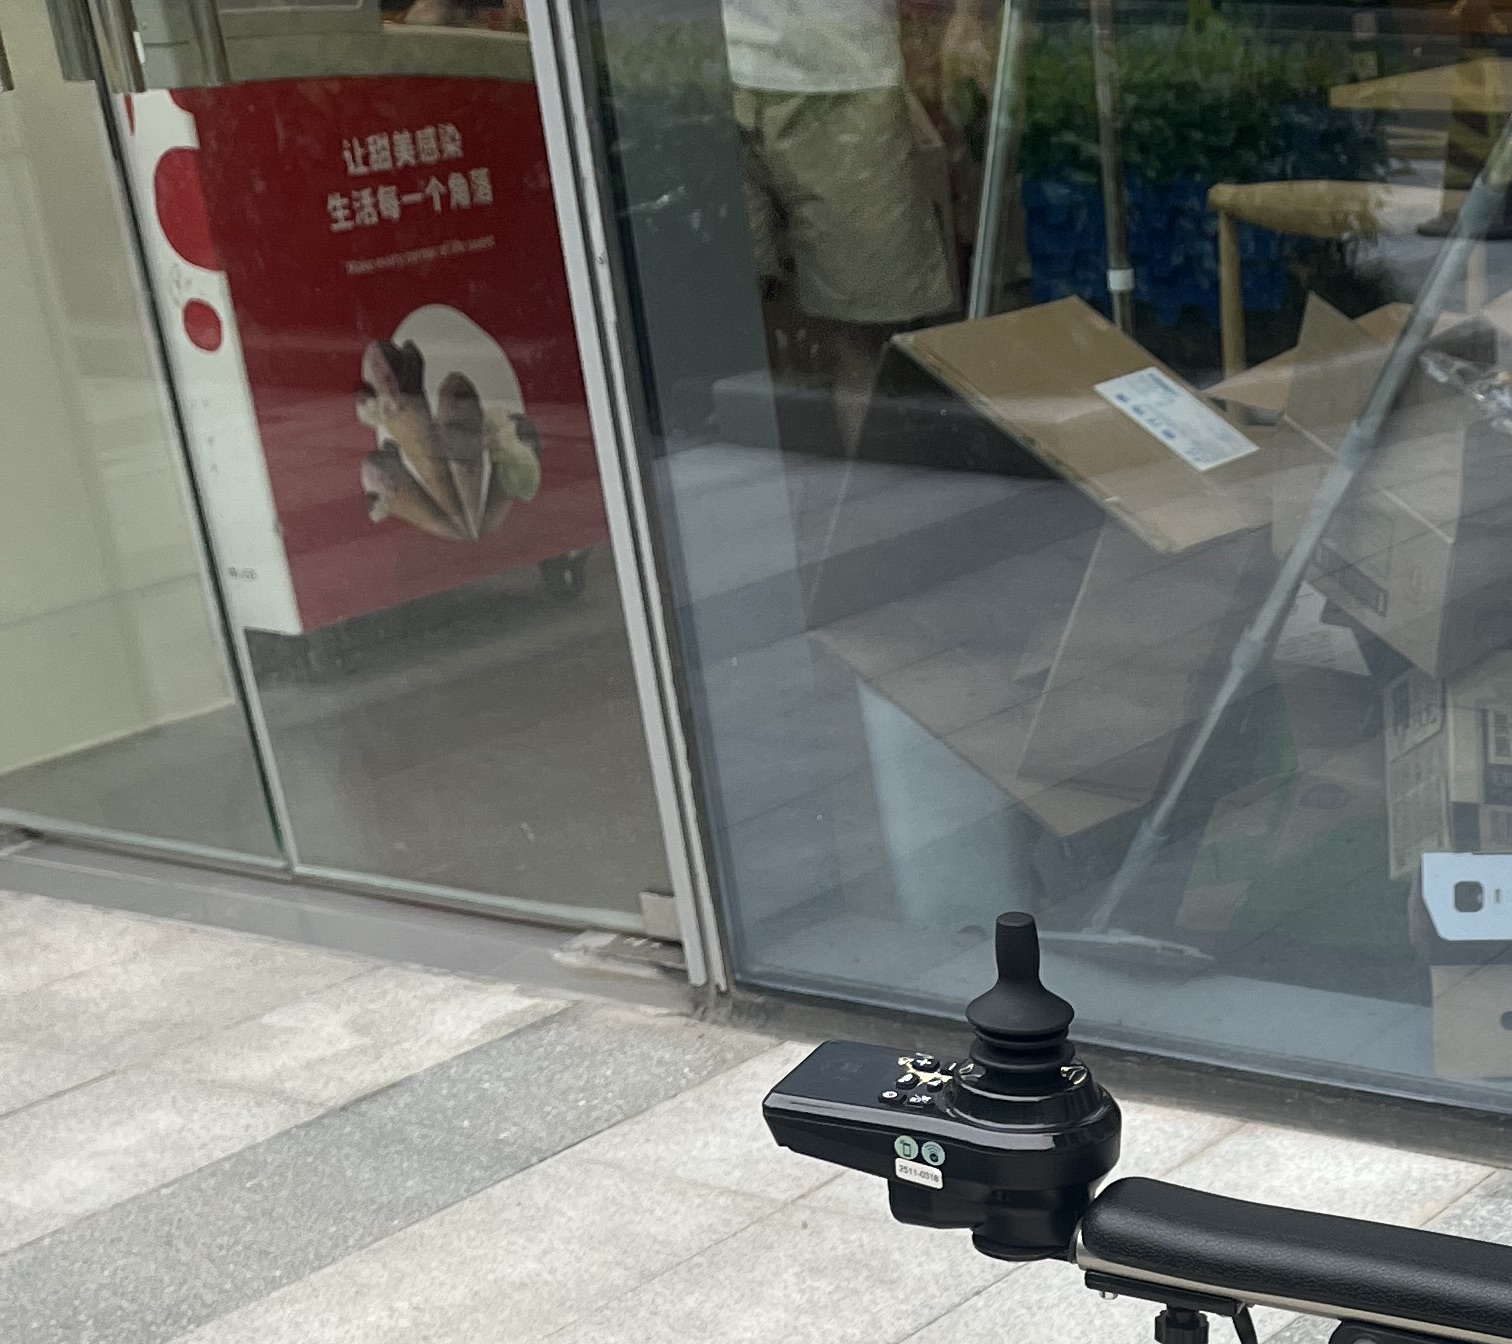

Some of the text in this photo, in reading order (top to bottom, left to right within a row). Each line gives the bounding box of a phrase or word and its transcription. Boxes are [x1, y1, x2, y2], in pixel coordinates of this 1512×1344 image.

[342, 122, 464, 175] 让甜美感染
[326, 167, 494, 232] 生活每一个角落
